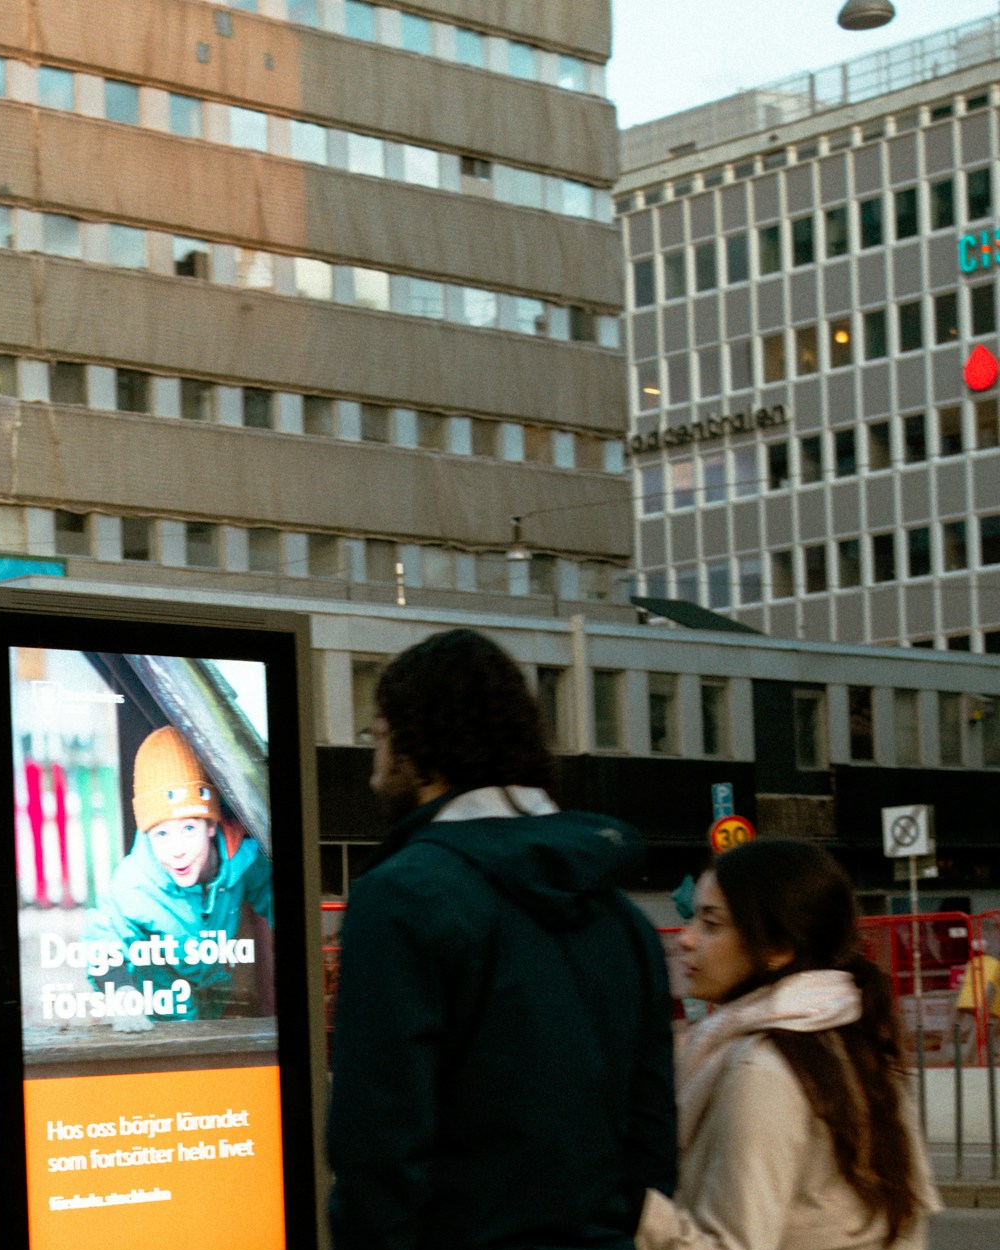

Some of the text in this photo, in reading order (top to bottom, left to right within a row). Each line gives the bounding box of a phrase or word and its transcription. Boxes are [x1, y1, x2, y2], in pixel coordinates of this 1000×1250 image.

[718, 826, 748, 848] 30
[41, 930, 255, 976] Dags att söka
[41, 979, 191, 1019] förskola?
[47, 1108, 250, 1140] Hos oss börjar lärandet
[47, 1138, 255, 1172] som fortsätter hela livet
